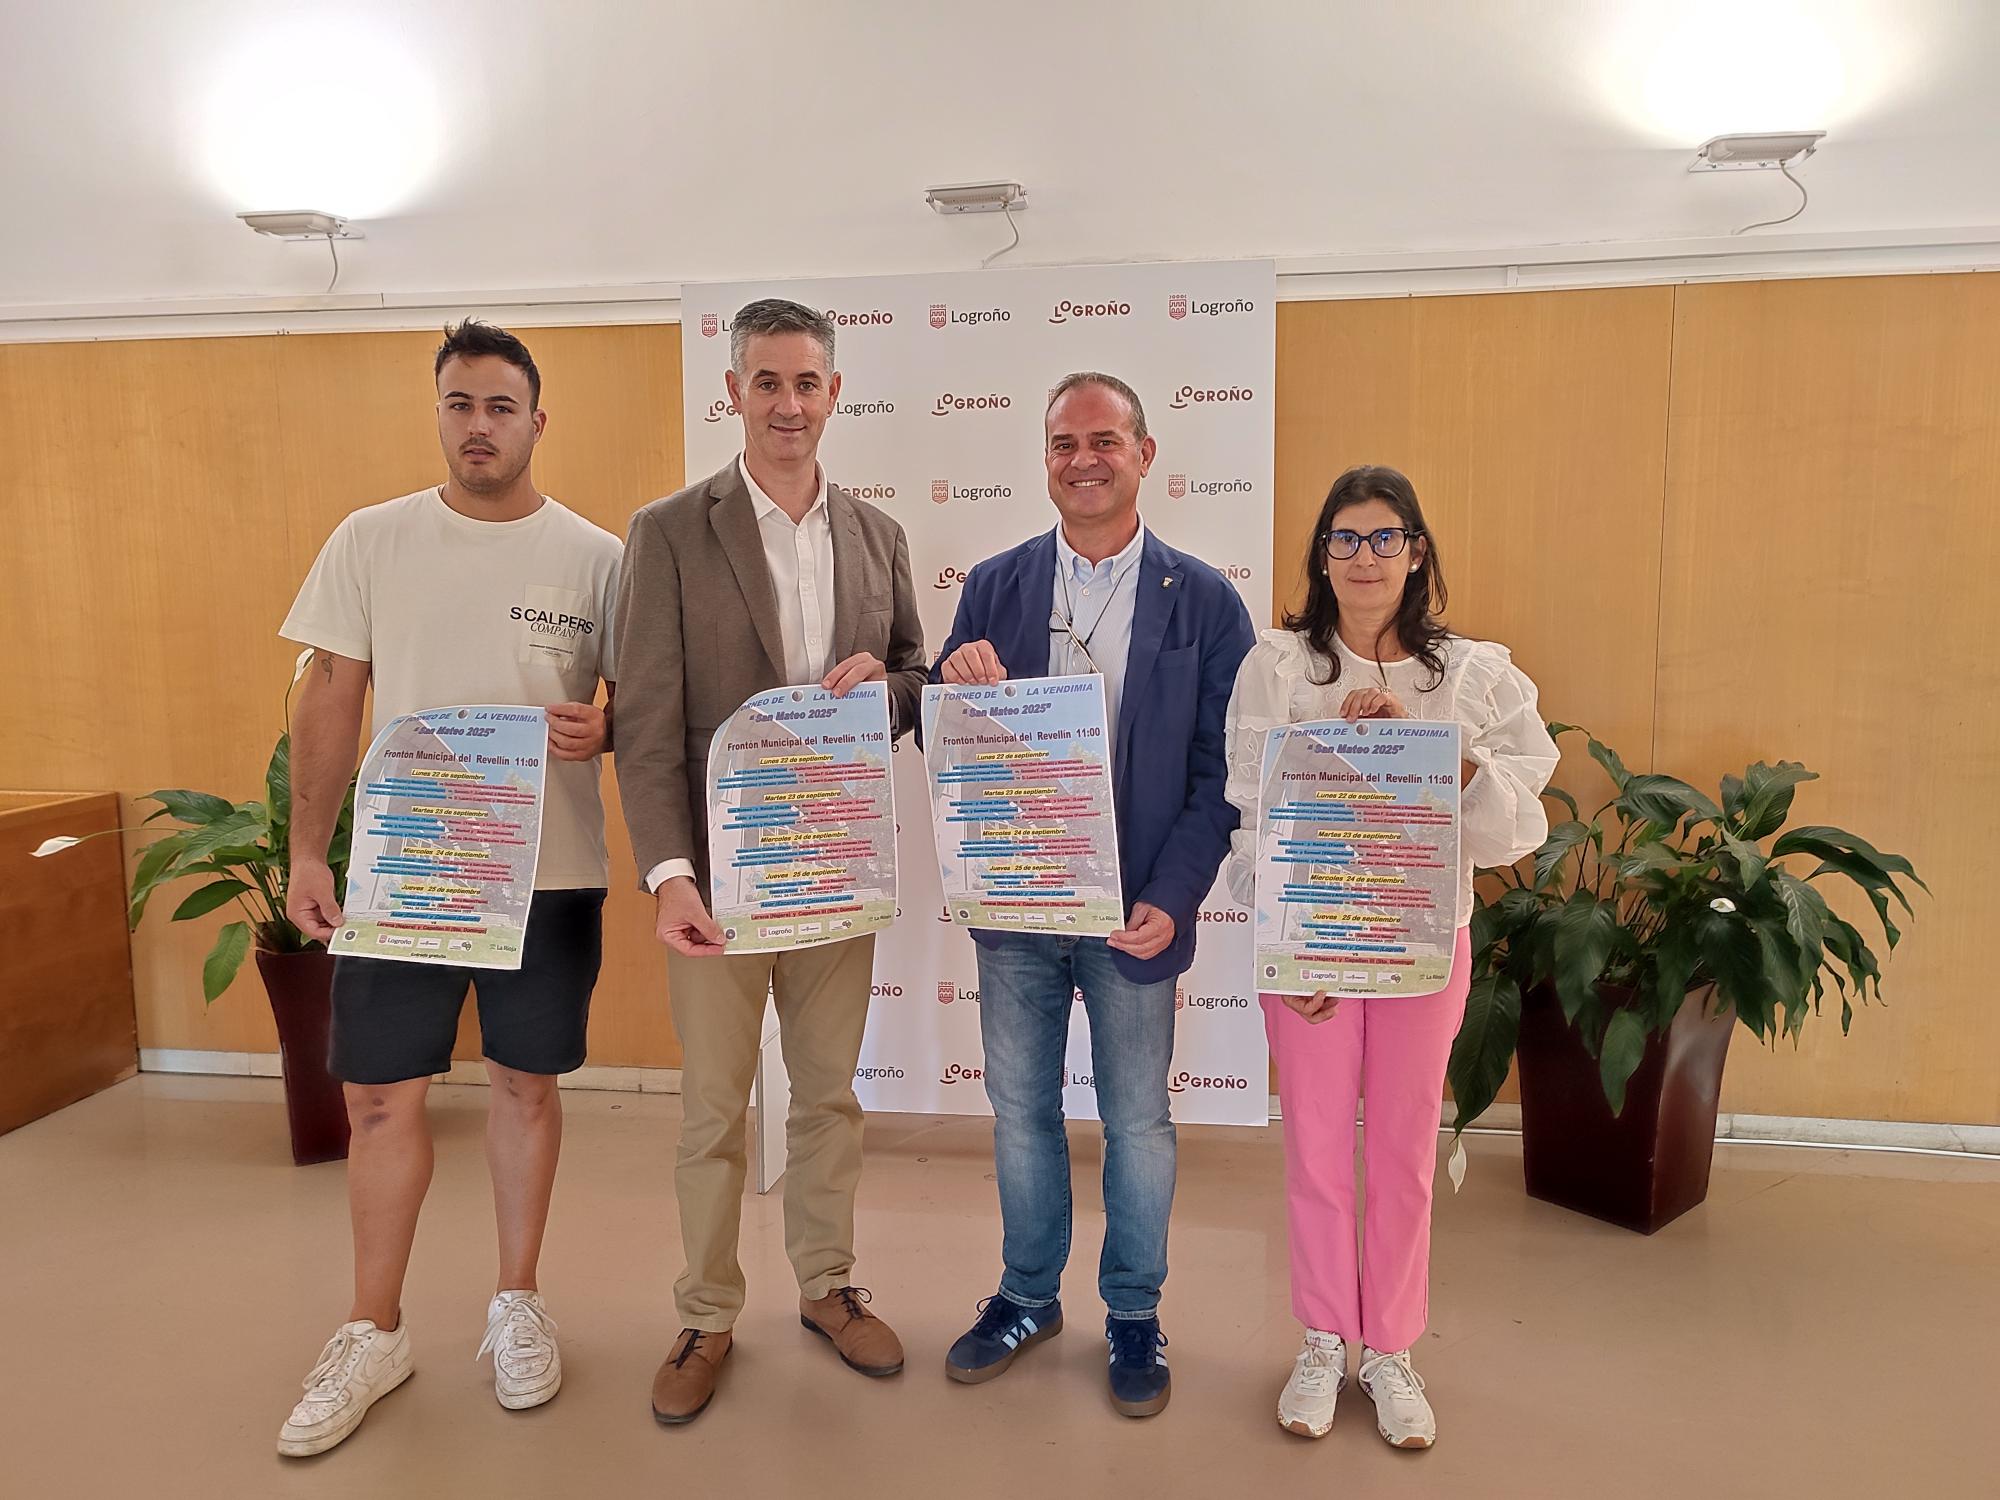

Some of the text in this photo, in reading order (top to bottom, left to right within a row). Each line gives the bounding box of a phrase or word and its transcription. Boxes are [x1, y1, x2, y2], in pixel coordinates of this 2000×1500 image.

[1054, 301, 1130, 317] LOGROÑO
[1192, 300, 1253, 316] Logroño
[826, 310, 893, 325] OGROÑO
[952, 308, 1010, 325] Logroño
[937, 393, 1011, 410] LOGROÑO
[1176, 386, 1253, 402] LOGROÑO
[837, 401, 894, 416] Logroño
[953, 485, 1011, 501] Logroño
[1191, 479, 1252, 495] Logroño
[510, 607, 594, 634] SCALPERS
[530, 622, 578, 639] COMPANY
[772, 696, 785, 704] DE
[930, 694, 940, 702] 34
[944, 692, 982, 700] TORNEO
[1026, 688, 1039, 696] LA
[1043, 684, 1093, 694] VENDIMIA
[475, 712, 488, 720] LA
[491, 713, 538, 722] VENDIMIA
[776, 711, 806, 720] Mateo
[990, 706, 1019, 716] Mateo
[436, 726, 464, 735] Mateo
[977, 733, 1016, 744] Municipal
[1020, 732, 1032, 741] del
[1076, 727, 1100, 738] 11:00
[1289, 728, 1330, 737] TORNEO
[1333, 728, 1348, 736] DE
[1379, 728, 1393, 736] LA
[1397, 728, 1449, 738] VENDIMIA
[761, 736, 802, 748] Municipal
[805, 736, 817, 745] del
[861, 732, 884, 742] 11:00
[1014, 751, 1049, 759] septiembre
[1337, 744, 1369, 754] Mateo
[416, 750, 456, 763] Municipal
[458, 754, 471, 762] del
[515, 757, 538, 767] 11:00
[799, 755, 834, 763] septiembre
[1282, 771, 1316, 780] Frontón
[1319, 771, 1363, 783] Municipal
[1366, 773, 1380, 782] del
[1428, 774, 1453, 784] 11:00
[1023, 788, 1057, 796] septiembre
[1196, 908, 1248, 923] GROÑO
[1189, 995, 1248, 1009] Logroño
[856, 1067, 904, 1079] ogroño
[945, 1064, 985, 1079] LOGR
[1174, 1072, 1247, 1089] LOGROÑO
